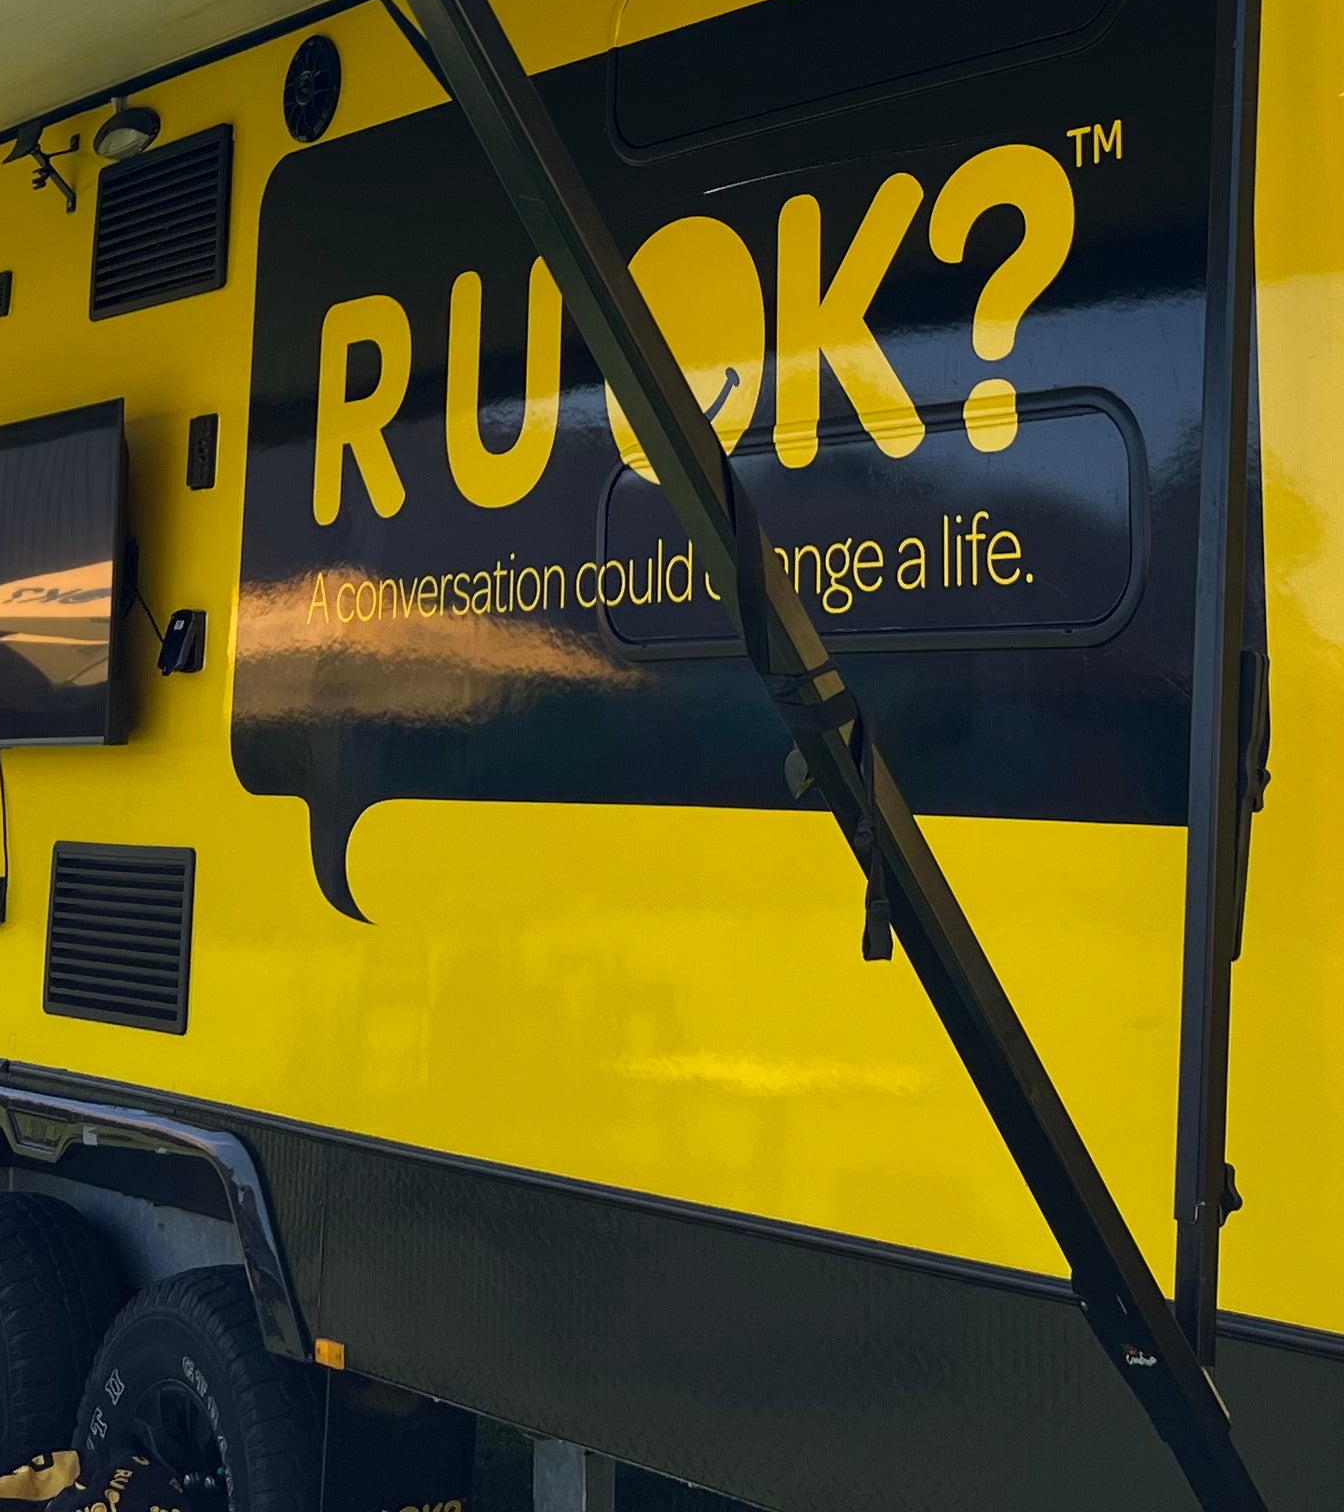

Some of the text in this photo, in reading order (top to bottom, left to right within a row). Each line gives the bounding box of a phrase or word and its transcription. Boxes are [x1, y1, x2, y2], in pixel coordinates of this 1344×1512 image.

[307, 572, 332, 626] A
[336, 553, 565, 625] conversation
[575, 538, 693, 609] could
[896, 537, 926, 590] a
[941, 510, 1034, 589] life.
